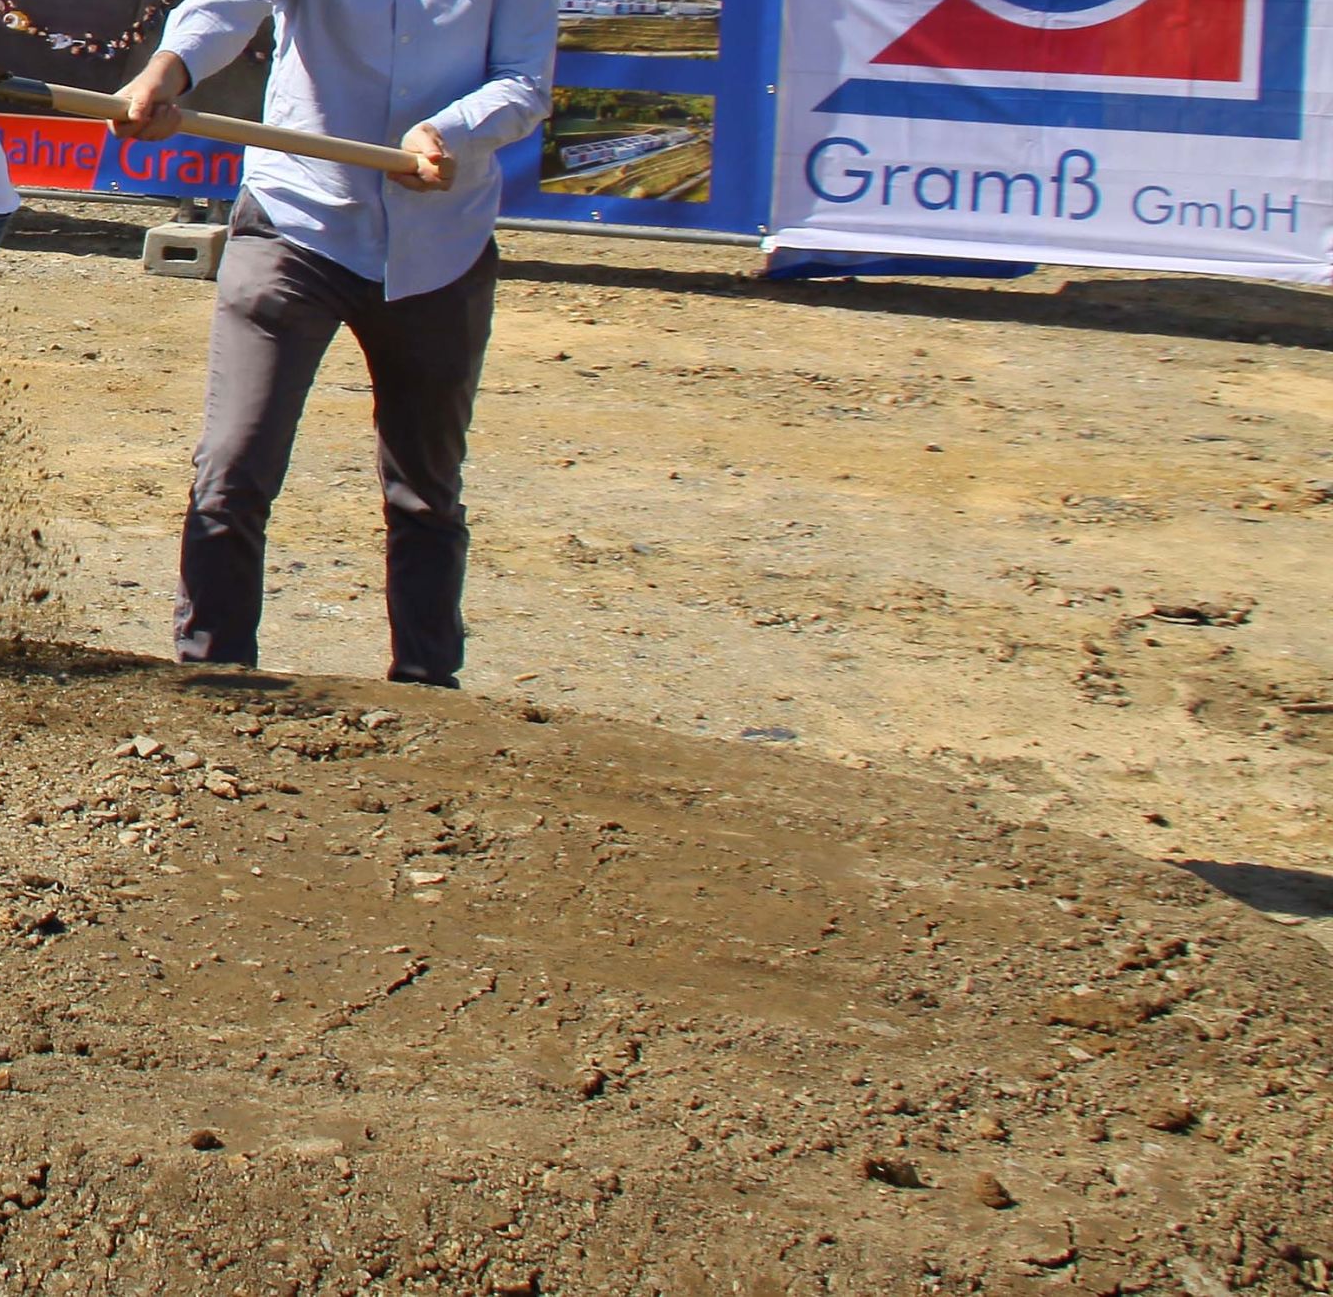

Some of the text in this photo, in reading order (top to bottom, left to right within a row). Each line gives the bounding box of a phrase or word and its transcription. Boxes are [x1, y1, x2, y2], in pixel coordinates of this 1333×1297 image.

[119, 136, 243, 185] Gram
[805, 136, 1299, 233] Gramß GmbH
